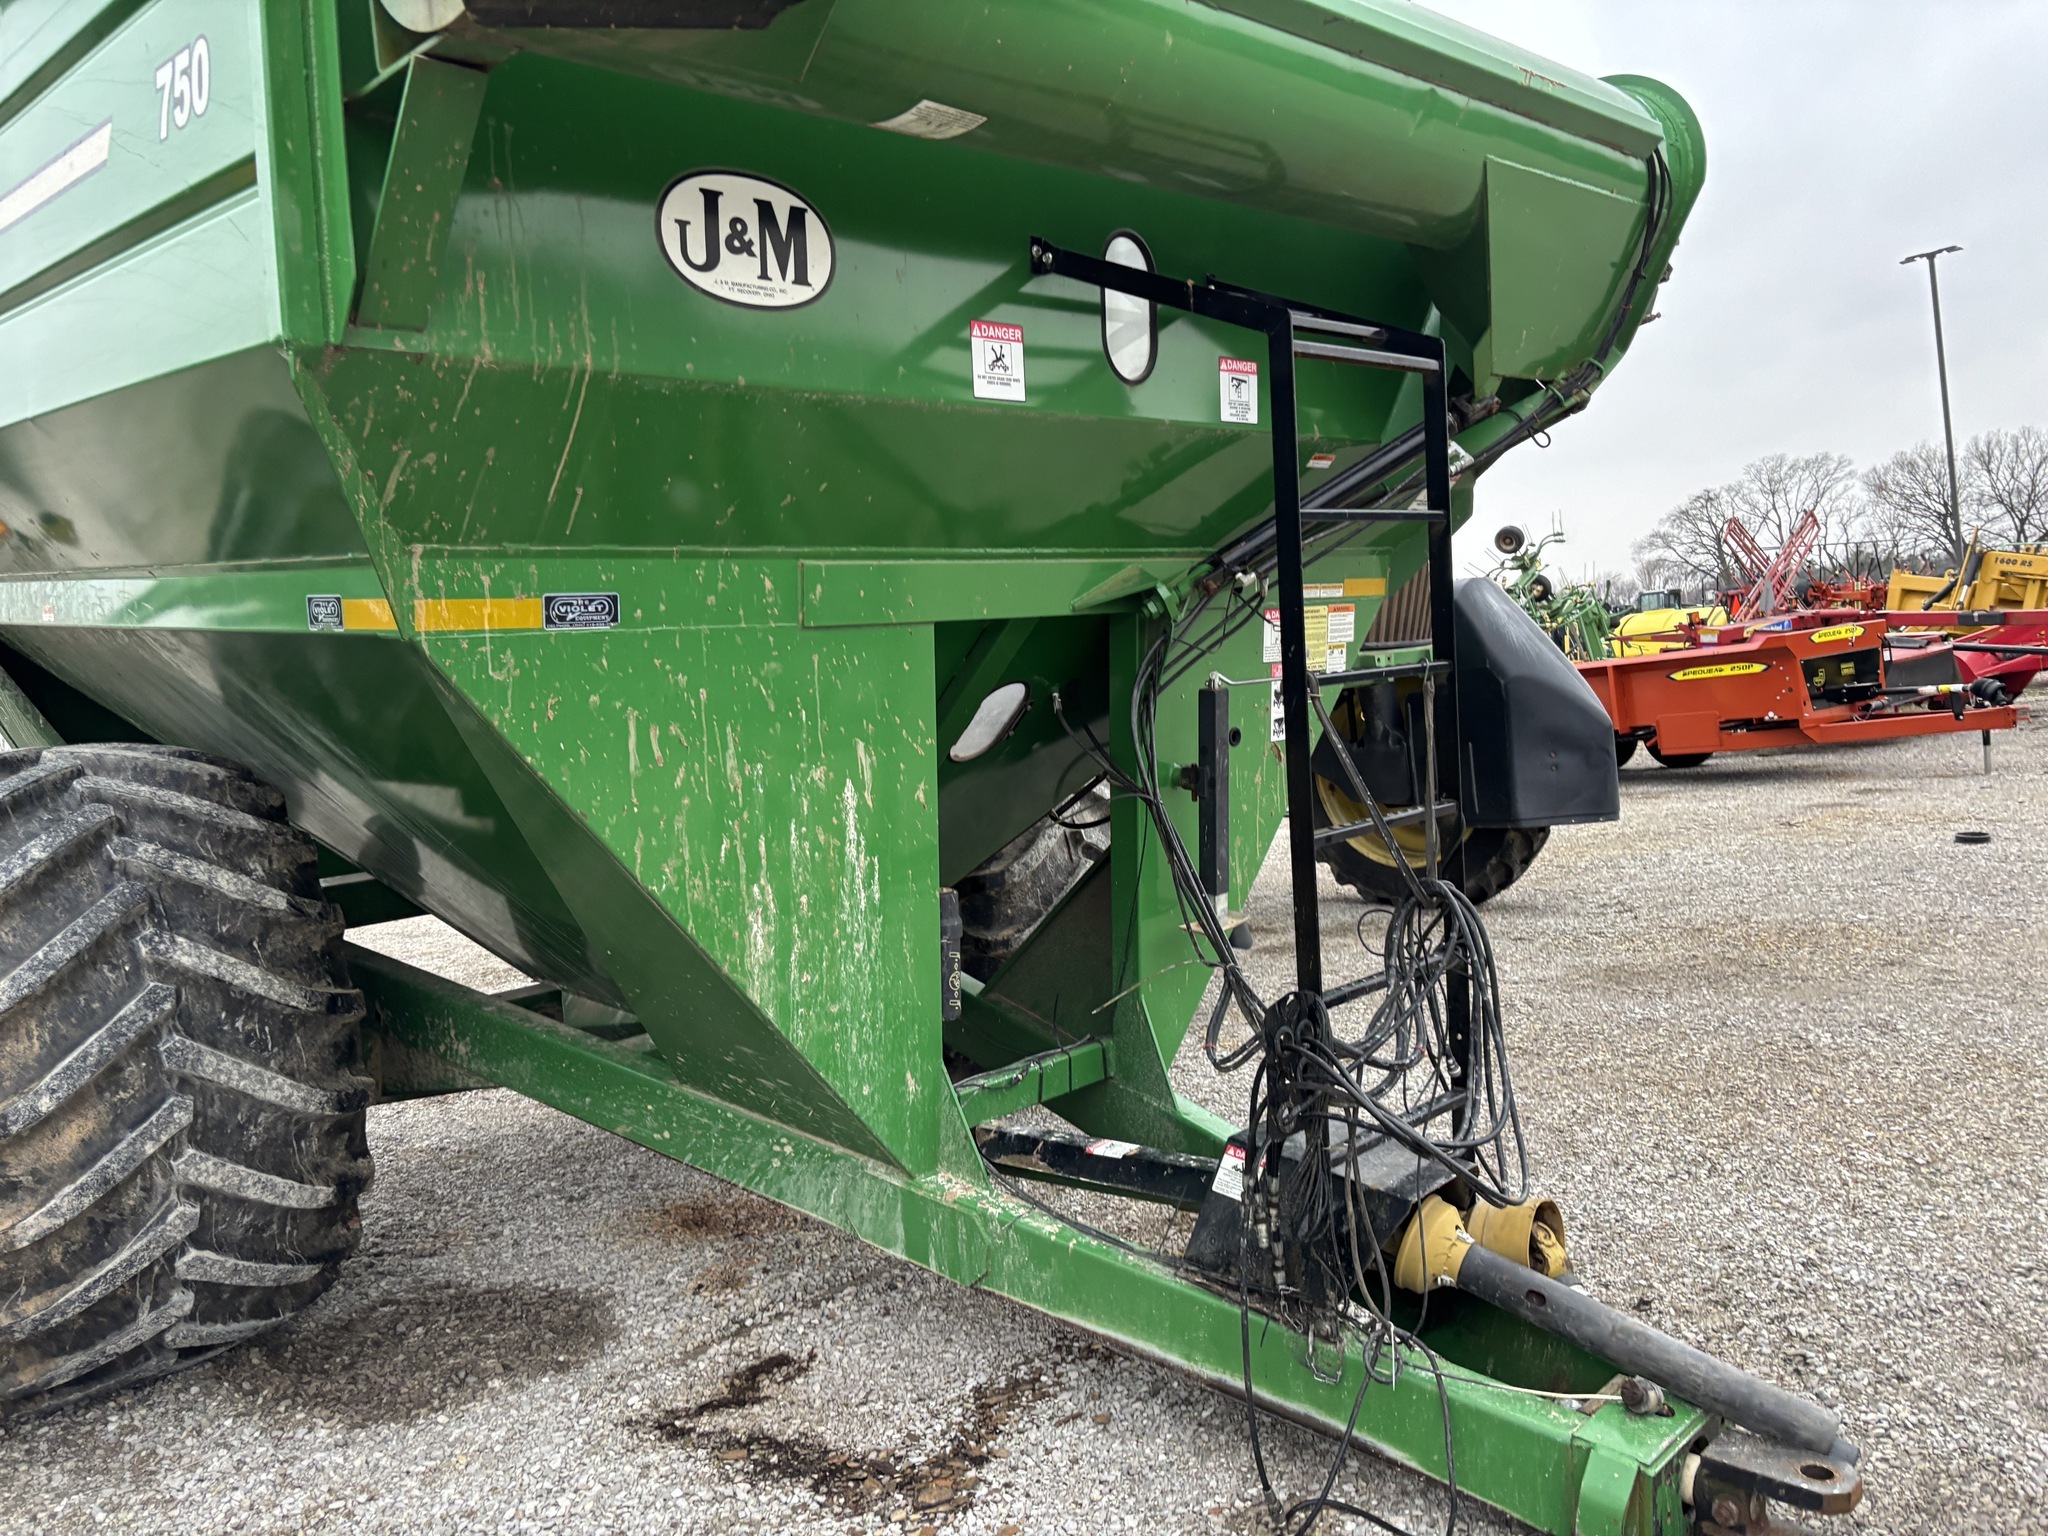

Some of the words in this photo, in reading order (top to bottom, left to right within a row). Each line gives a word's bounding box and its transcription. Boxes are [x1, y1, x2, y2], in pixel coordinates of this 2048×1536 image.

[155, 35, 210, 142] 750
[674, 187, 813, 287] J&M
[981, 324, 1022, 341] DANGER
[1227, 359, 1257, 372] DANGER
[1994, 556, 2018, 565] 1600
[558, 604, 604, 613] VIOLET
